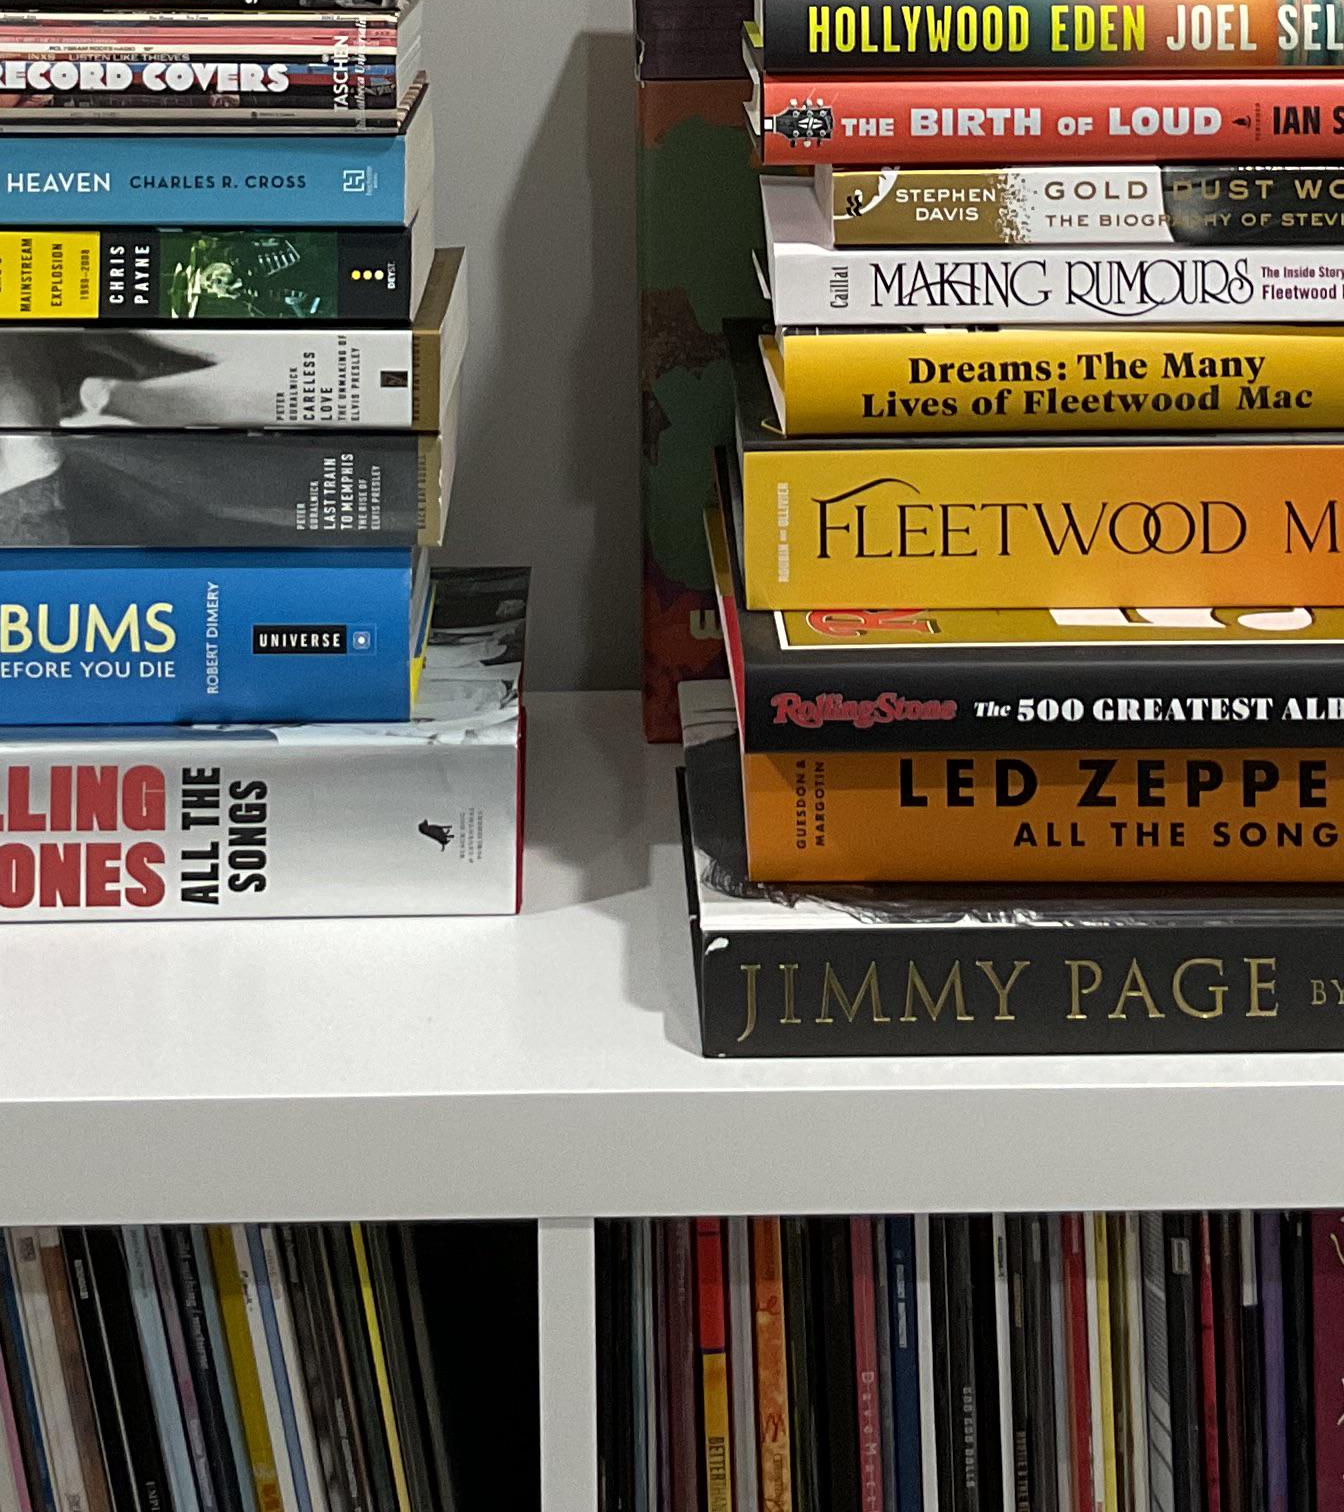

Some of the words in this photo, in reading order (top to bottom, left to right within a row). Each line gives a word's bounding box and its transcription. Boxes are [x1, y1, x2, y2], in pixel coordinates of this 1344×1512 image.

[808, 5, 1030, 53] HOLLYWOOD
[1051, 5, 1145, 52] EDEN
[1167, 4, 1256, 51] JOEL
[841, 116, 894, 136] THE
[910, 108, 1040, 136] BIRTH
[1058, 116, 1093, 135] OF
[1108, 108, 1222, 136] LOUD
[1273, 106, 1321, 135] IAN
[7, 172, 111, 193] HEAVEN
[130, 174, 216, 189] CHARLES
[222, 175, 235, 189] R.
[242, 174, 306, 189] CROSS
[909, 357, 1068, 384] Dreams:
[1077, 355, 1149, 380] The
[1161, 354, 1266, 385] Many
[862, 392, 961, 418] Lives
[970, 389, 1011, 416] of
[1023, 388, 1221, 417] Fleetwood
[1237, 385, 1312, 409] Mac
[811, 478, 1247, 560] FLEETWOOD
[974, 702, 1011, 719] The
[1017, 700, 1084, 722] 500
[1094, 700, 1273, 722] GREATEST
[897, 760, 1036, 807] LED
[737, 961, 1031, 1043] JIMMY
[1064, 956, 1280, 1020] PAGE
